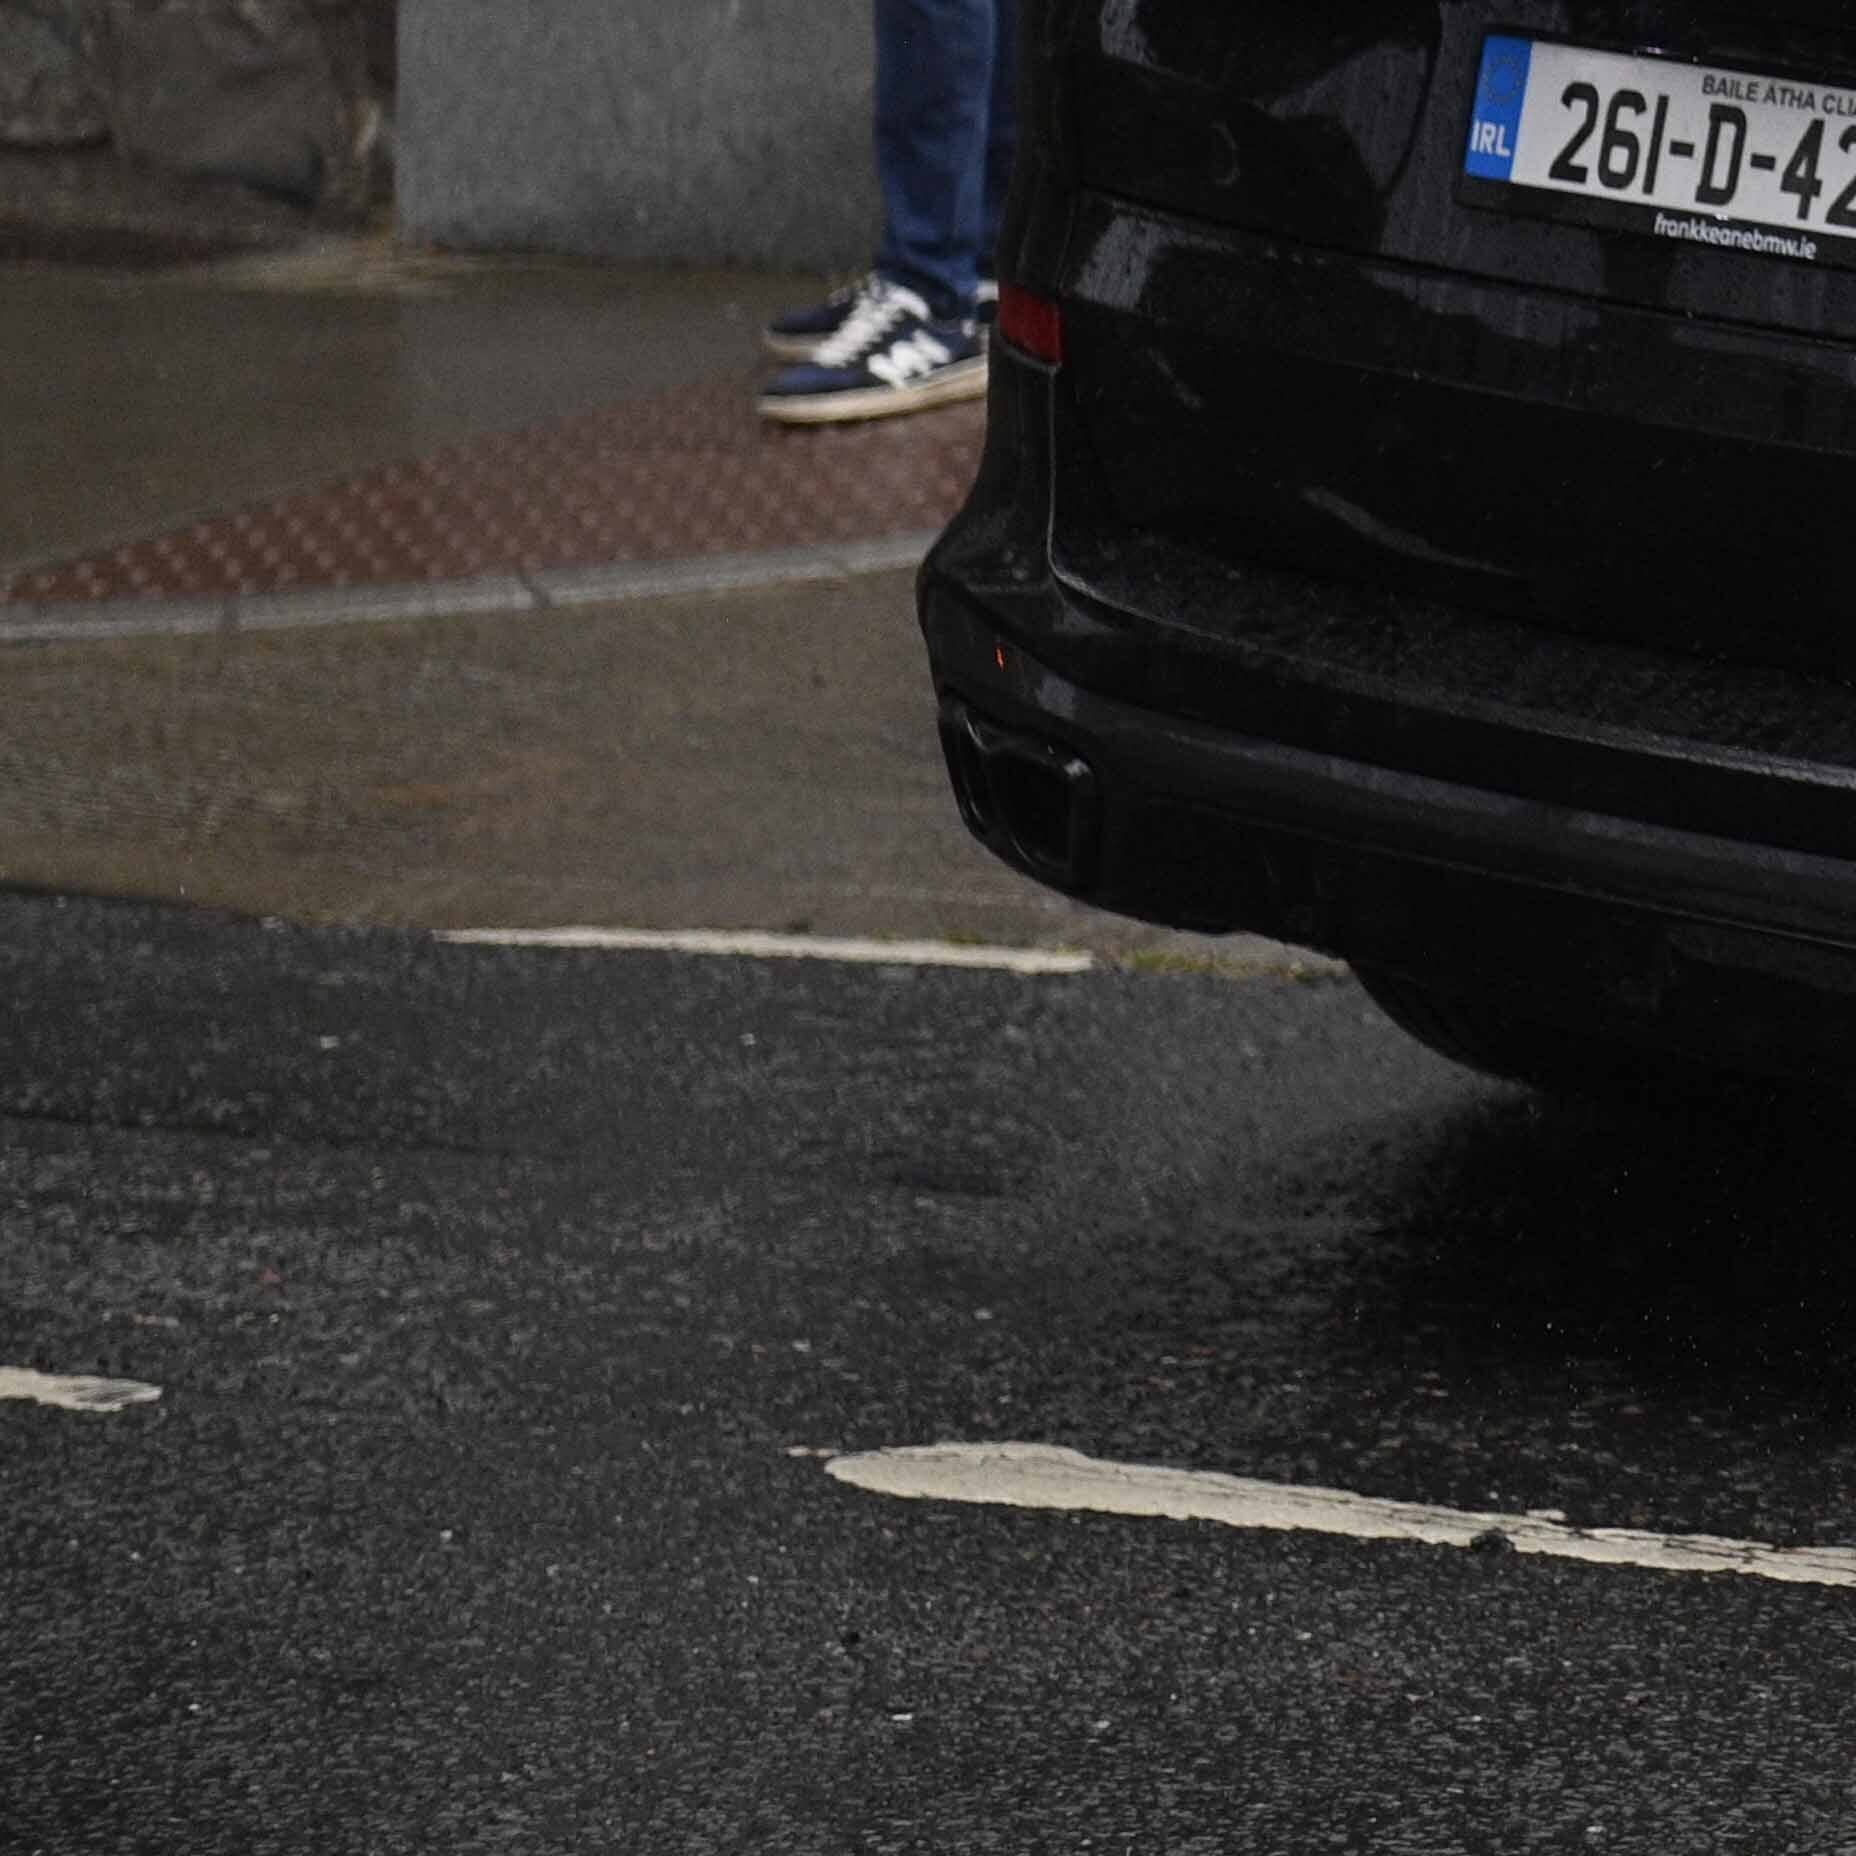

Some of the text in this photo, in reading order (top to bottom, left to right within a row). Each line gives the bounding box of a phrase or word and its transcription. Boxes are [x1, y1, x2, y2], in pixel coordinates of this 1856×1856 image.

[1702, 74, 1760, 102] BAILE
[1470, 120, 1512, 158] IRL
[1654, 211, 1818, 260] frankkeanebmw.ie
